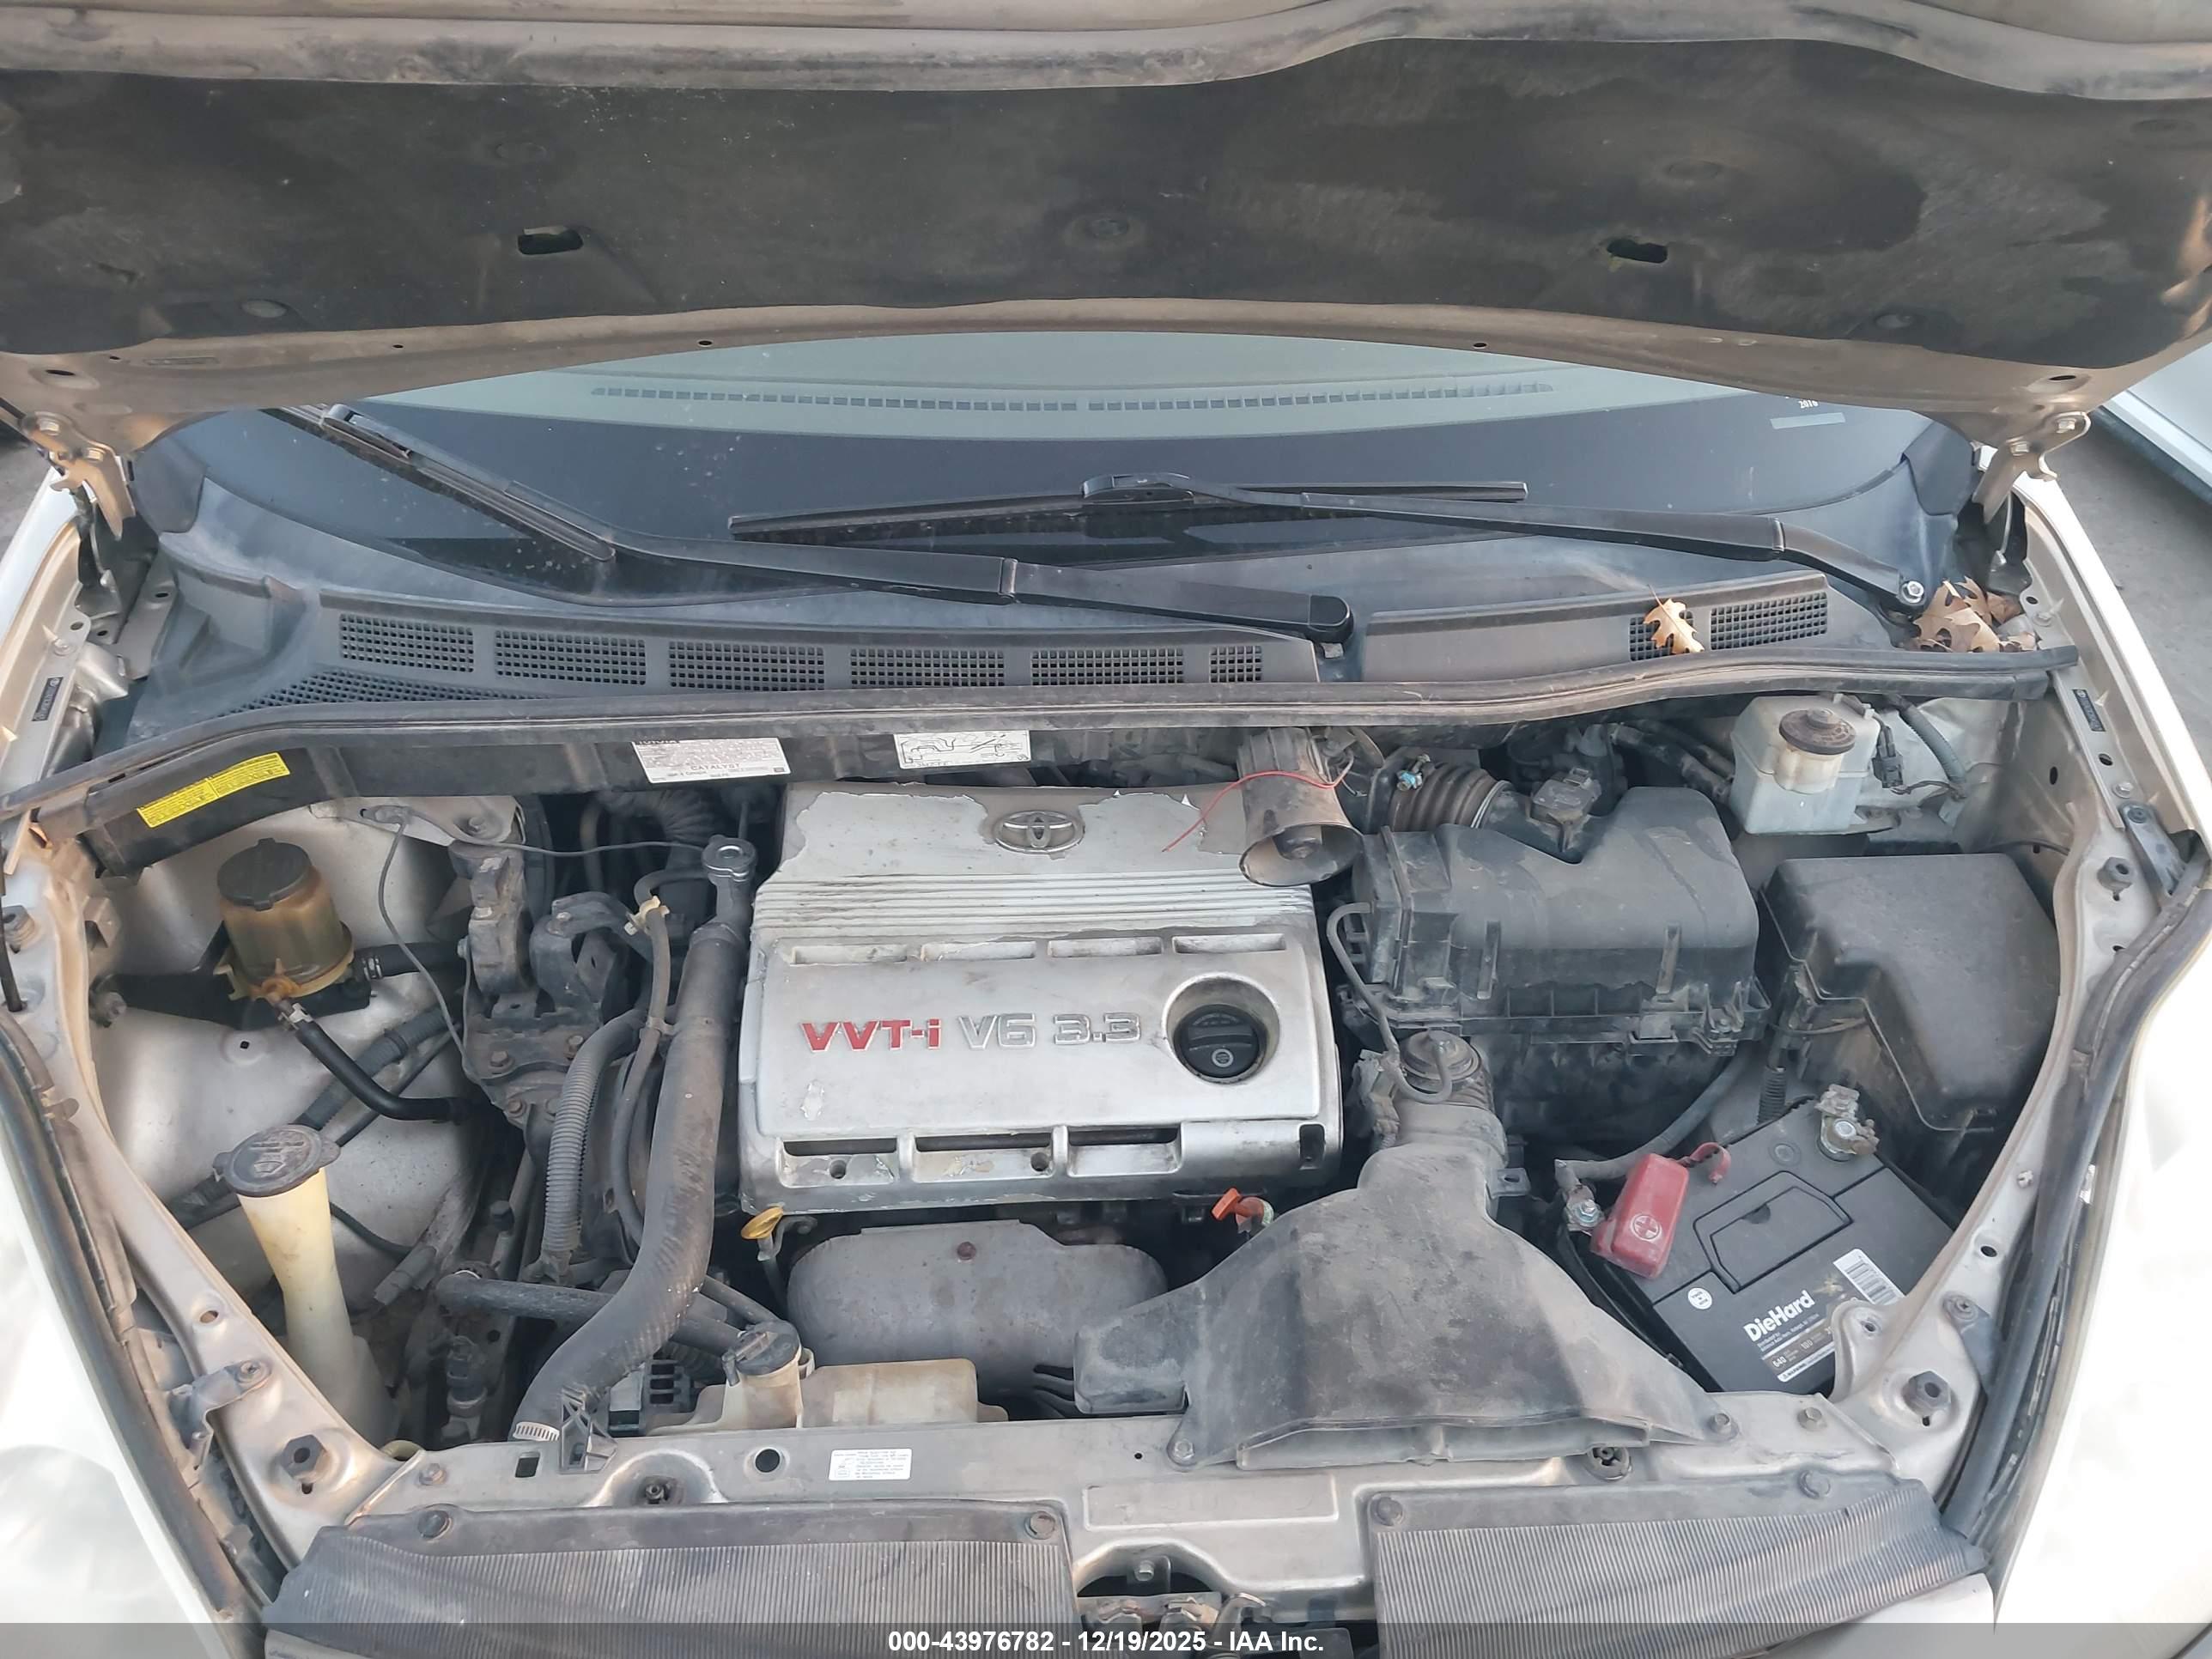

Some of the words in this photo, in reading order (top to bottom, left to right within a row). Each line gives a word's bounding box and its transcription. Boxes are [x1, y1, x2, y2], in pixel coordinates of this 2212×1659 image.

[799, 1017, 942, 1053] VVT-i
[957, 1012, 1036, 1051] V6
[1053, 1011, 1142, 1045] 3.3
[1743, 1290, 1815, 1342] DieHard
